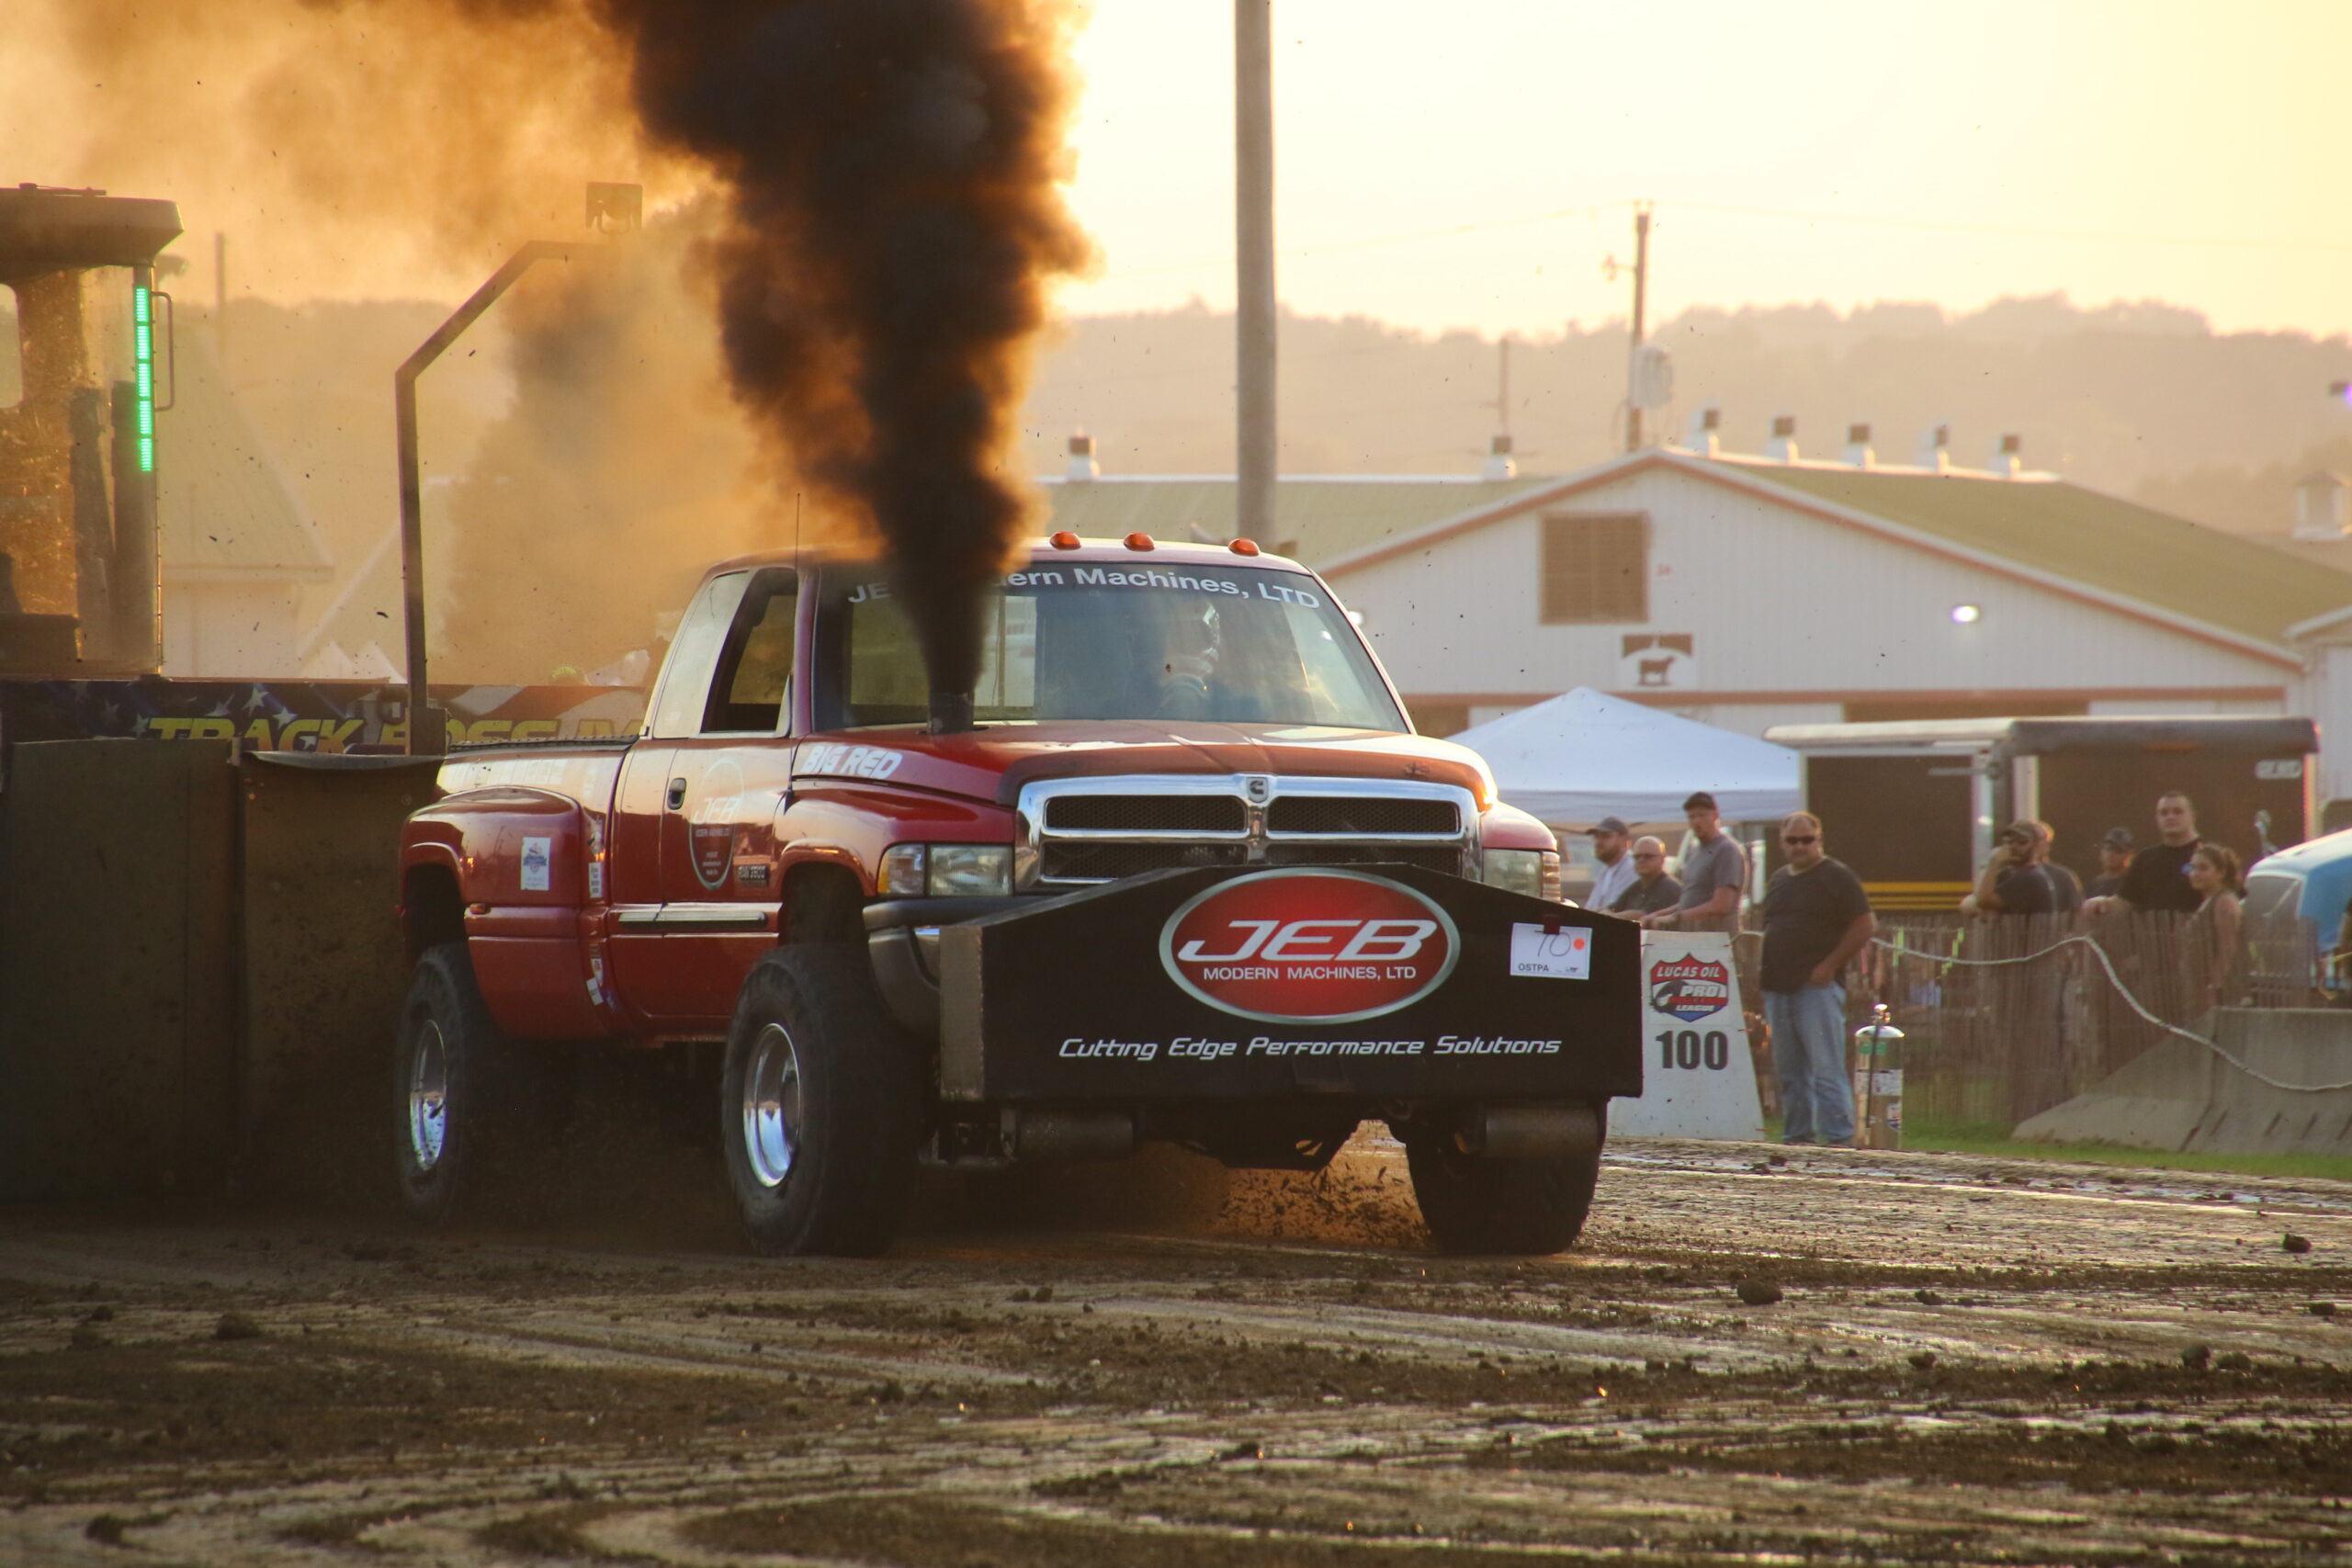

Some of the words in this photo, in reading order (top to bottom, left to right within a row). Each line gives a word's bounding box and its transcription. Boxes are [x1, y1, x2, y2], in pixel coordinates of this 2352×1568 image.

[1073, 568, 1249, 599] Machines,
[1258, 582, 1320, 609] LTD
[800, 744, 851, 774] BIG
[839, 746, 903, 780] RED
[1178, 919, 1438, 962] JEB
[1203, 967, 1279, 980] MODERN
[1287, 966, 1381, 981] MACHINES,
[1385, 966, 1417, 979] LTD
[1518, 963, 1550, 972] OSTPA
[1657, 966, 1698, 977] LUCAS
[1700, 966, 1720, 978] OIL
[1679, 985, 1720, 997] PRO
[1058, 1038, 1159, 1061] Cutting
[1168, 1037, 1238, 1060] Edge
[1245, 1036, 1425, 1055] Performance
[1433, 1035, 1562, 1055] Solutions
[1656, 1030, 1728, 1070] 100
